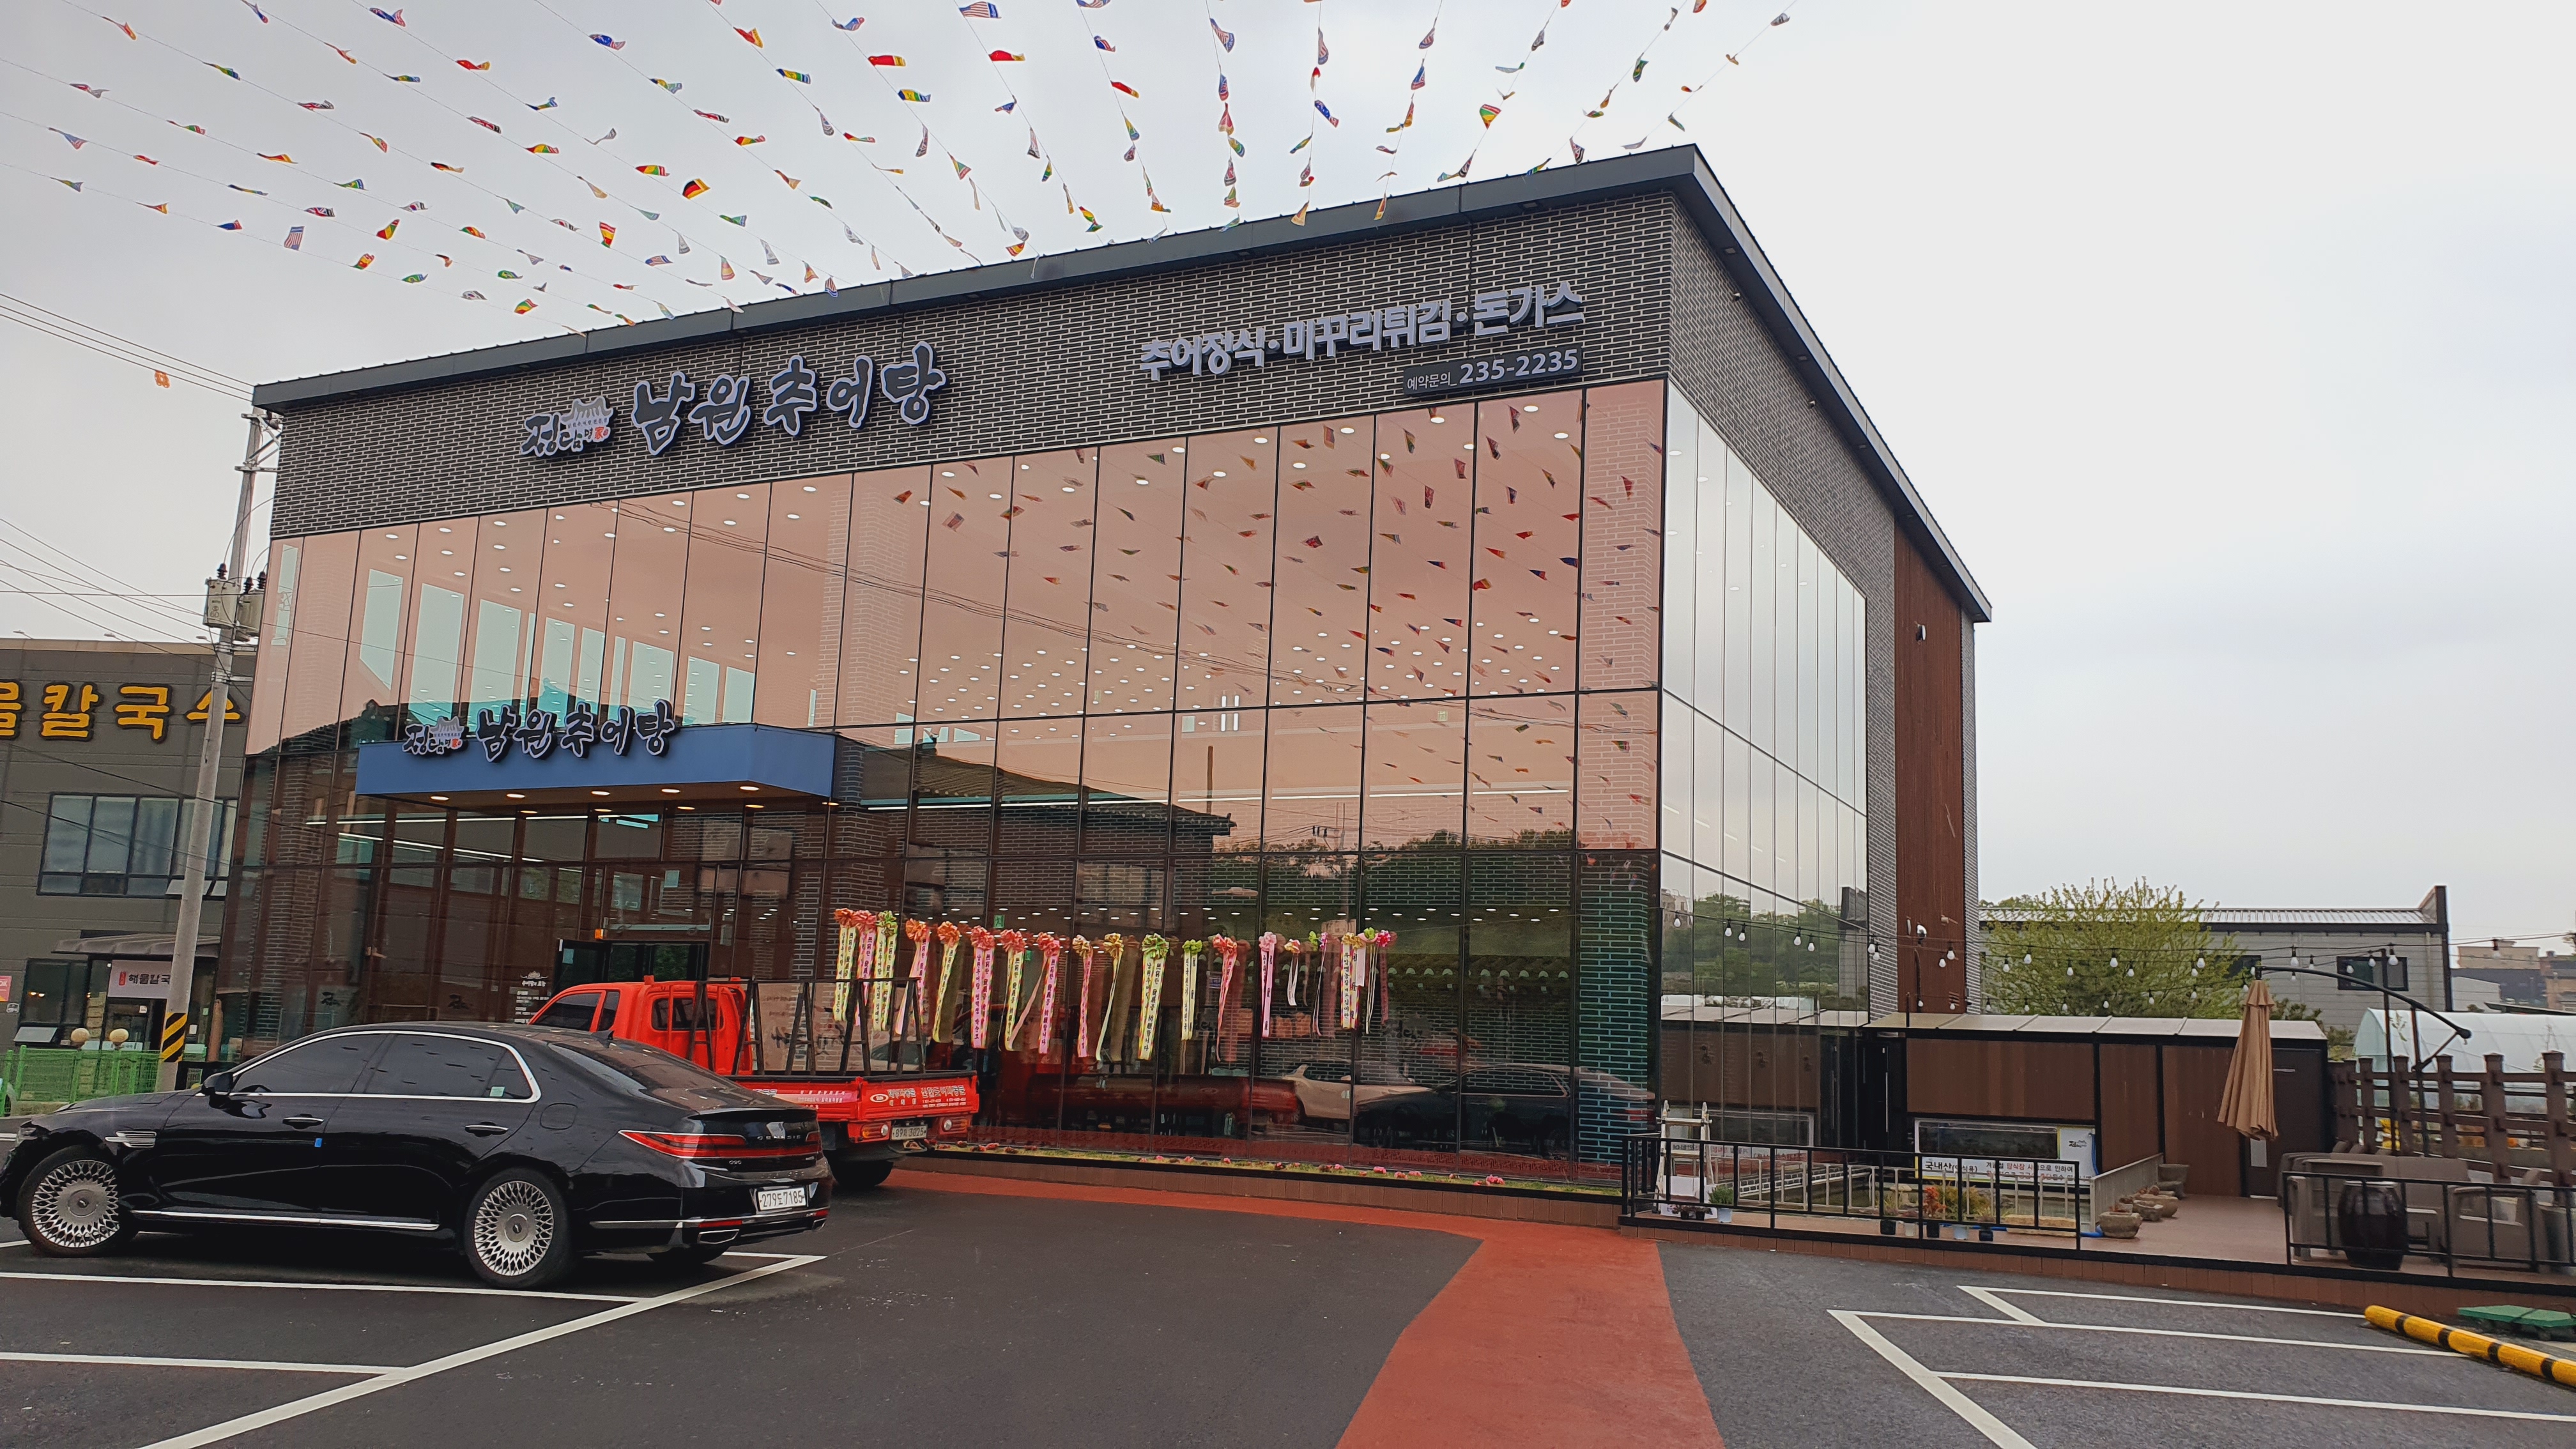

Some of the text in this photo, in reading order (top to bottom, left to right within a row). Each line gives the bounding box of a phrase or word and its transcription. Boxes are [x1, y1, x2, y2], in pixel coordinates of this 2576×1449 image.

[1473, 281, 1585, 337] 돈가스
[1459, 349, 1578, 384] 235-2235
[632, 341, 947, 455] 남원추어탕
[476, 700, 675, 762] 남원추어탕
